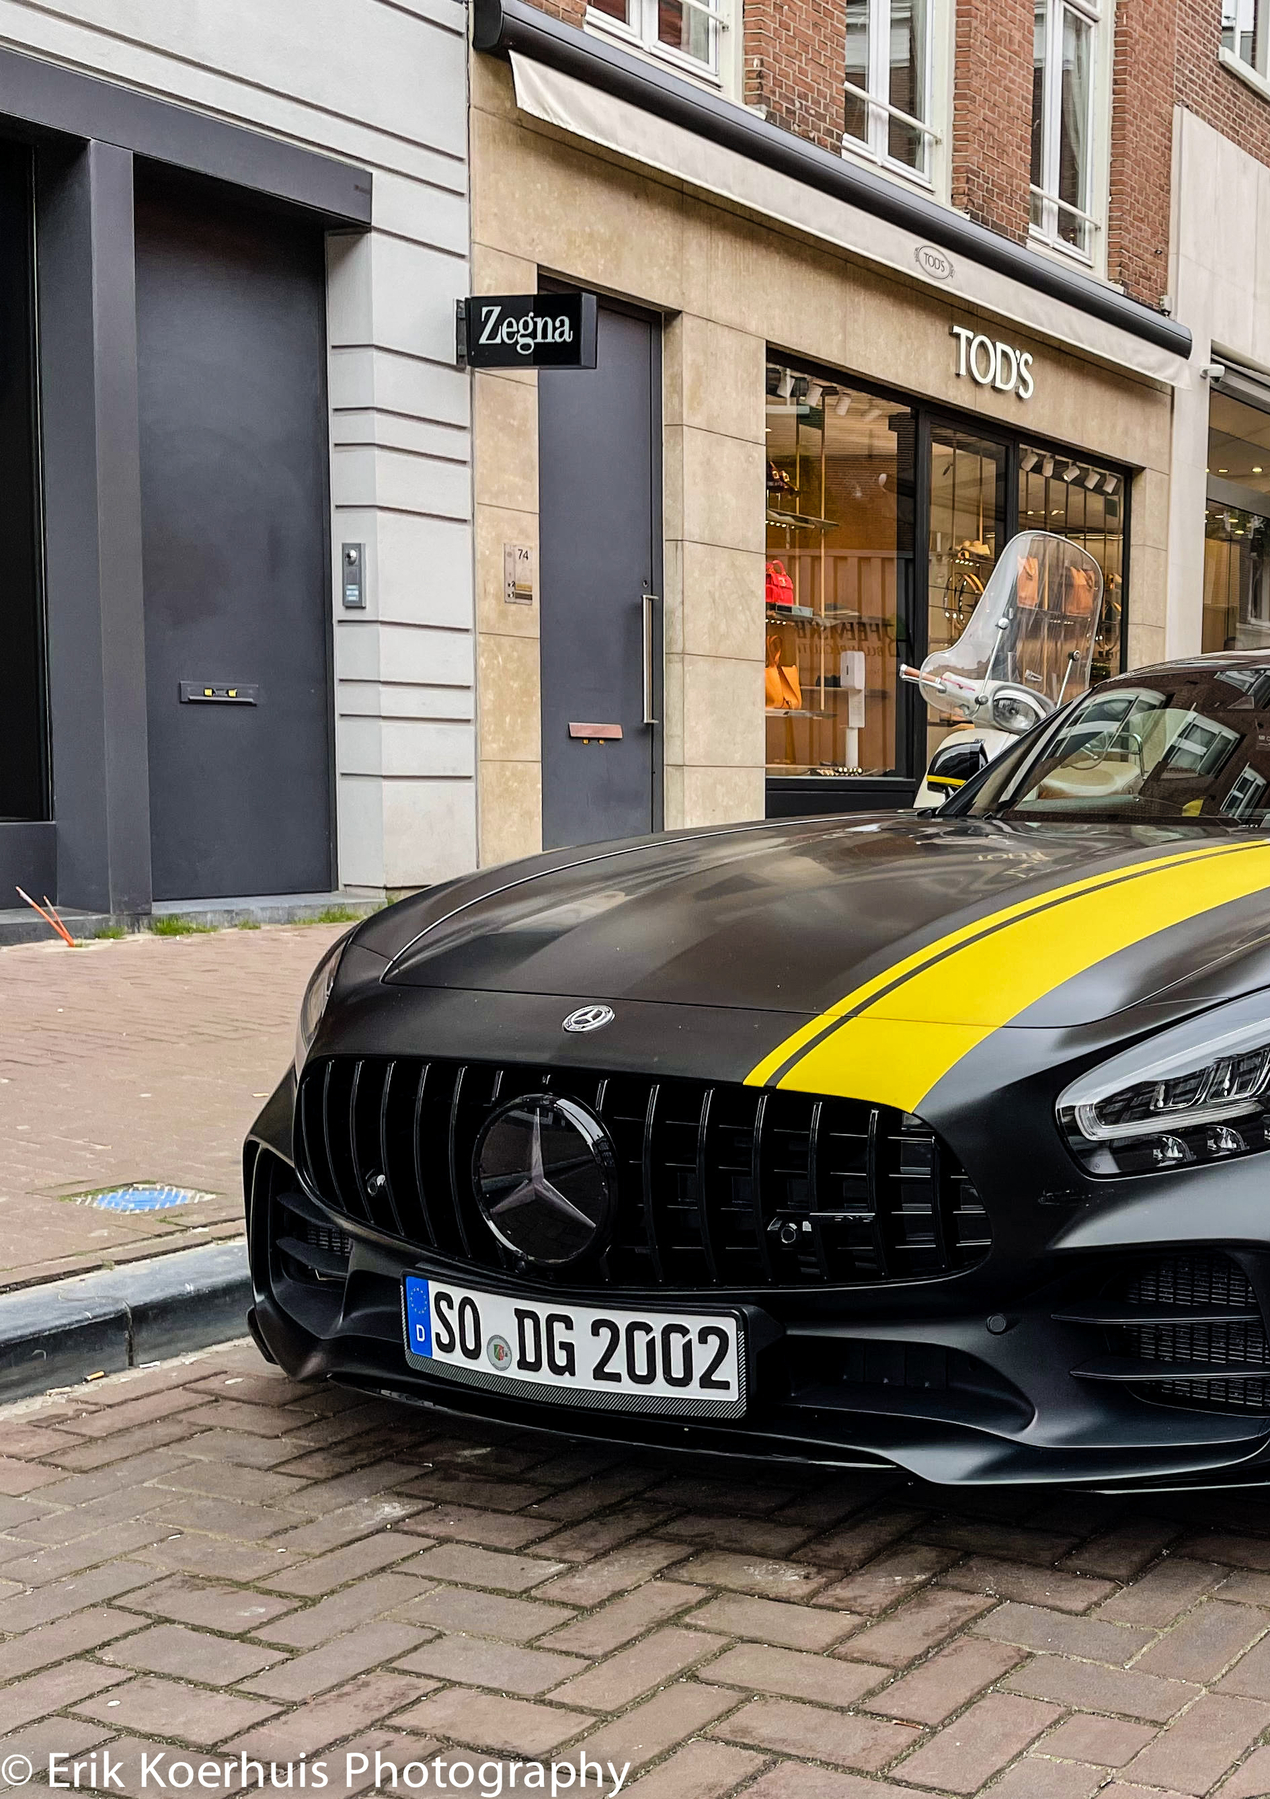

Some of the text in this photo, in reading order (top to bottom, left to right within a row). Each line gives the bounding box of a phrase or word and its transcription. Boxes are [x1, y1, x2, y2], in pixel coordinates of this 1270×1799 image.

[923, 252, 946, 273] TOD'S
[479, 305, 573, 355] Zegna
[950, 325, 1035, 400] TOD'S
[517, 548, 529, 561] 74
[416, 1323, 426, 1343] D
[433, 1290, 731, 1391] SO DG 2002
